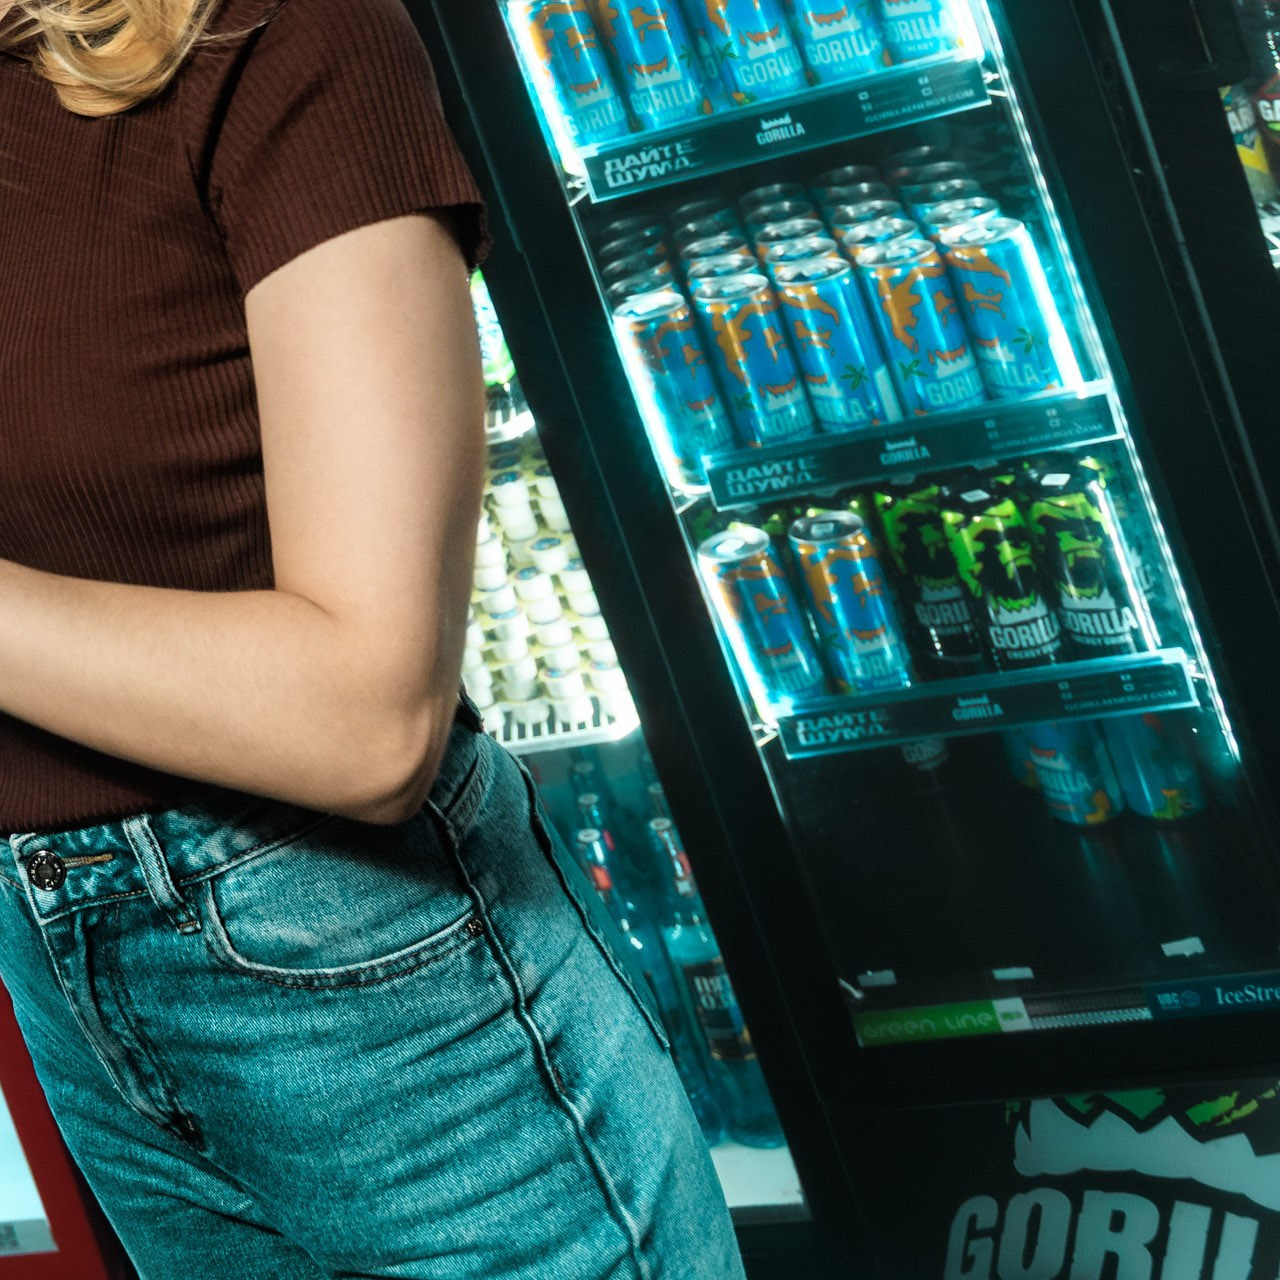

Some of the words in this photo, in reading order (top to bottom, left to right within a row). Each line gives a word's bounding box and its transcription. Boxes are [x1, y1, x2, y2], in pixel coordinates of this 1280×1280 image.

[630, 80, 702, 116] GORILLA
[756, 121, 807, 147] GORILLA
[603, 138, 696, 174] ДАЙТЕ
[943, 1187, 1280, 1280] GORIL
